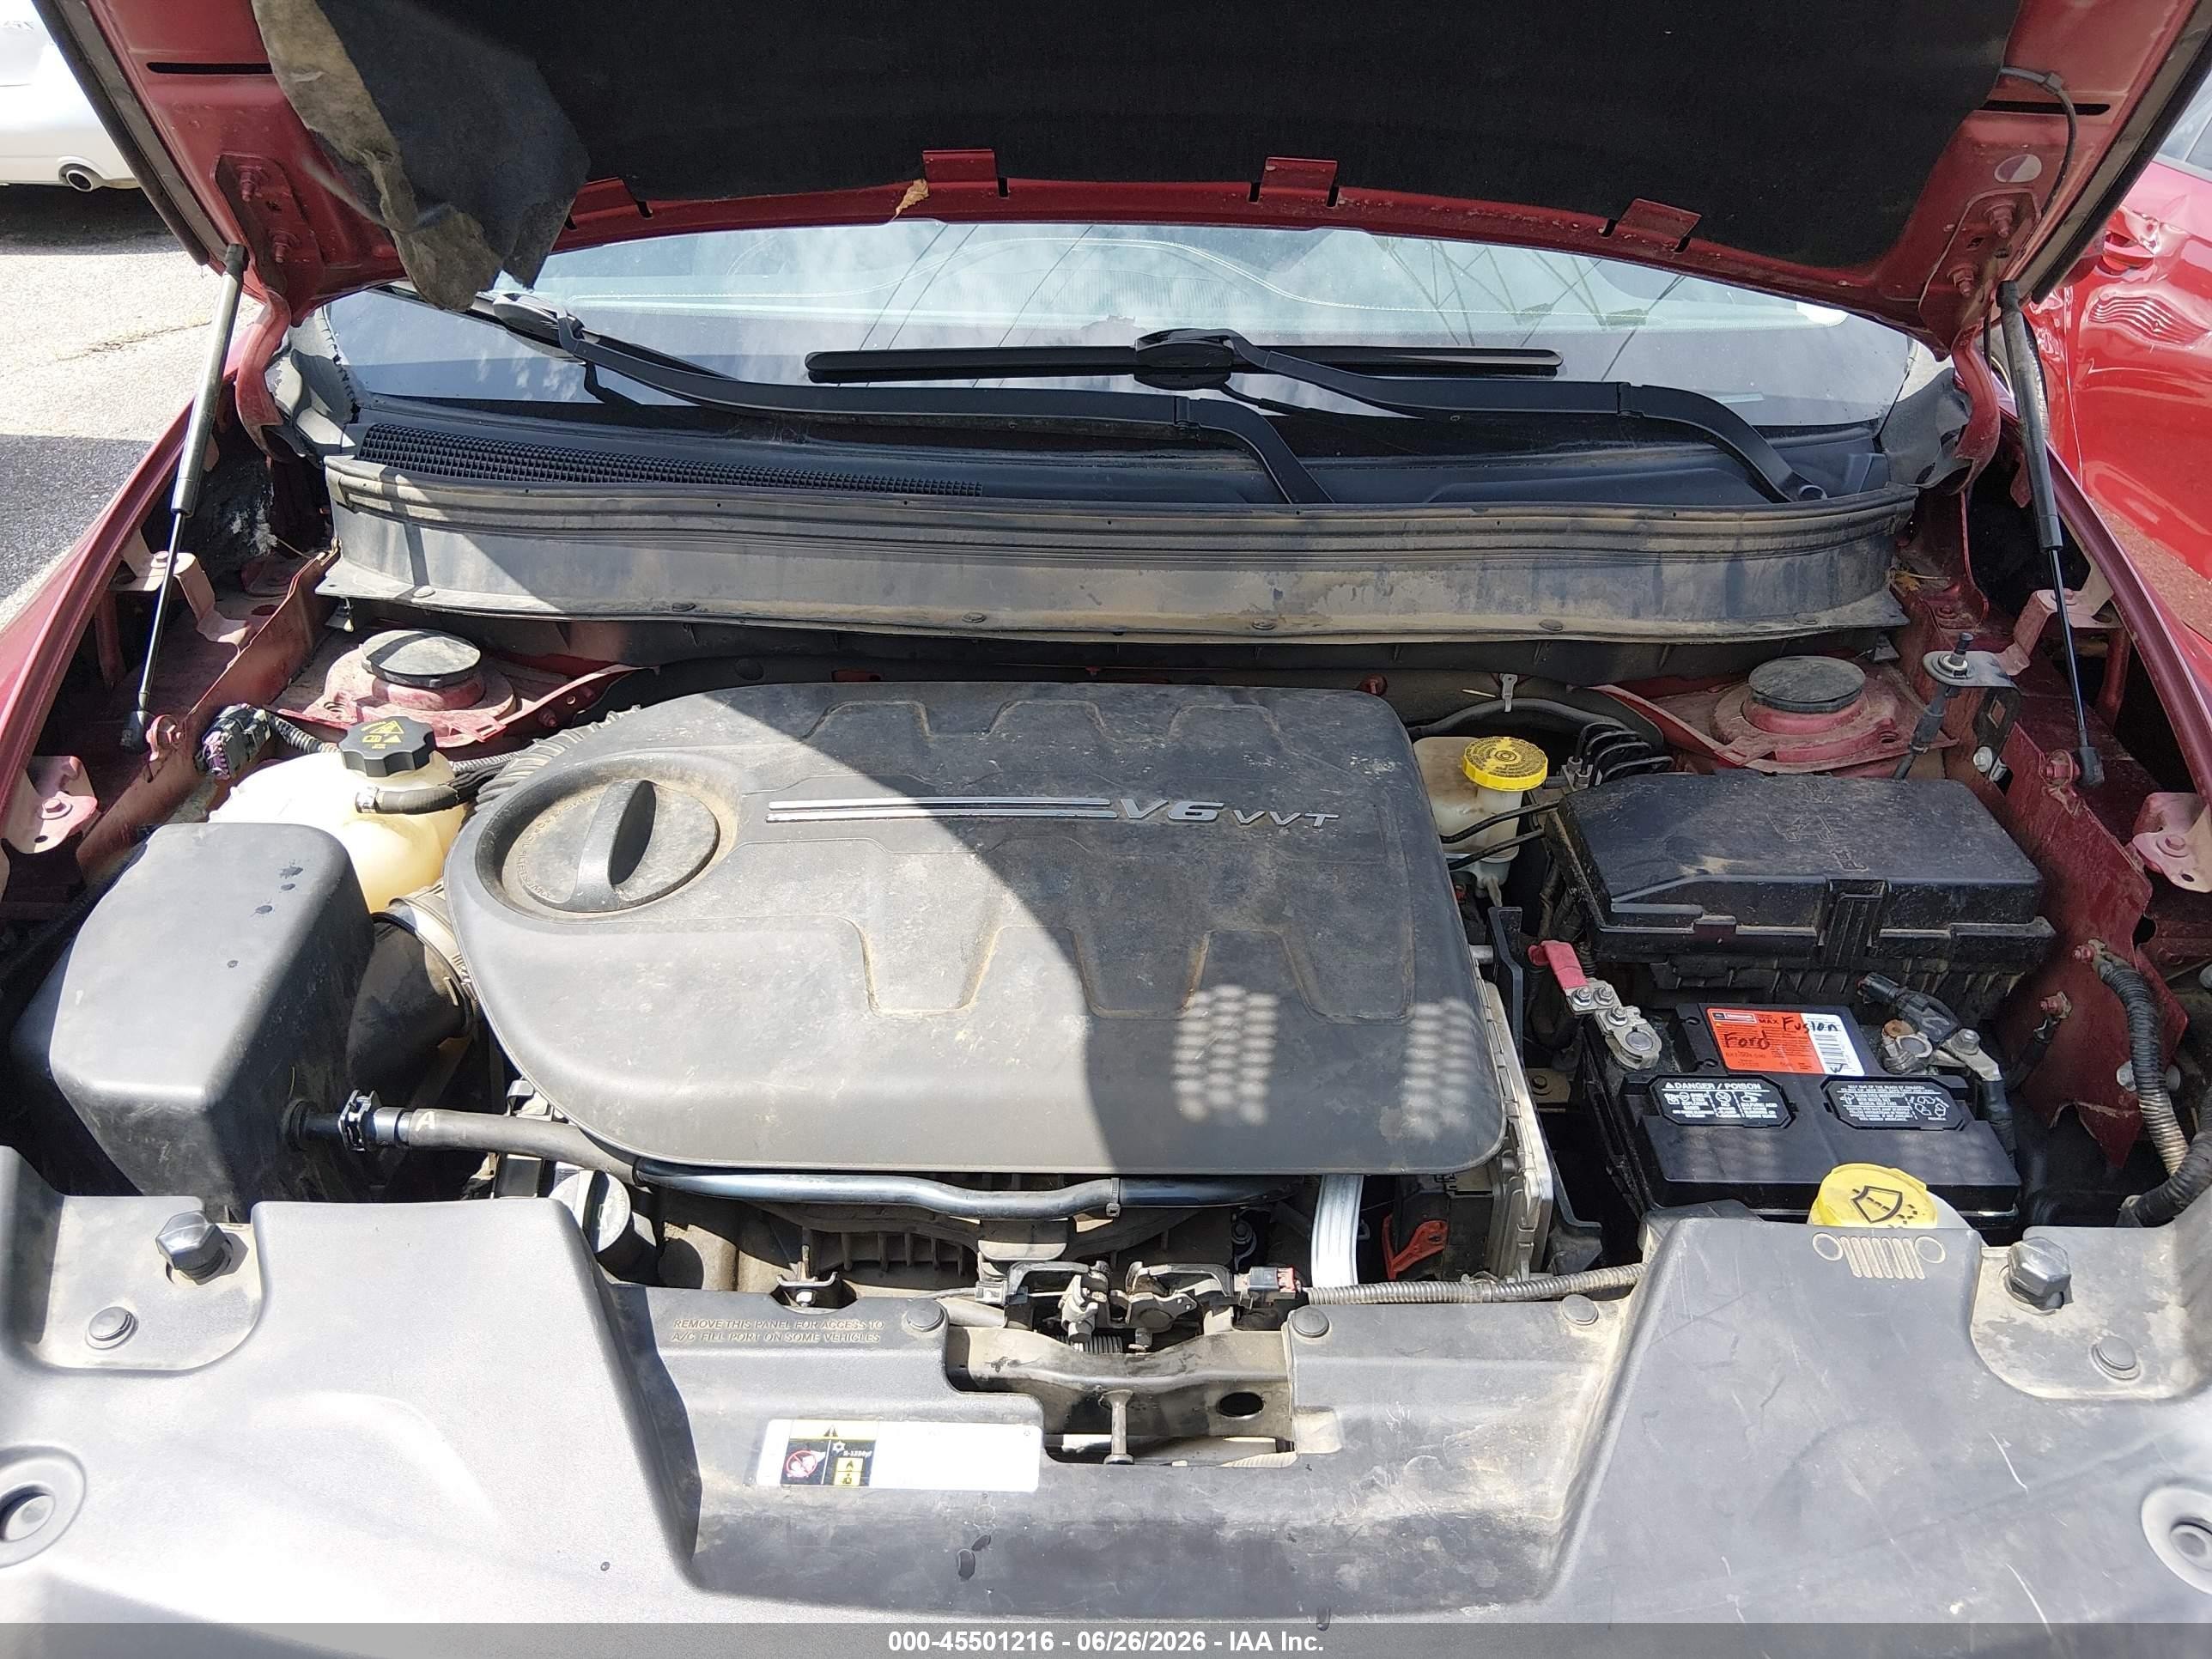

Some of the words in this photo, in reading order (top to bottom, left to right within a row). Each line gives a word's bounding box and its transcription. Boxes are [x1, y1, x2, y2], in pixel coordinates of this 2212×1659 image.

[1121, 798, 1224, 822] V6
[1233, 809, 1340, 830] VVT
[1782, 1016, 1839, 1034] Fusion
[1723, 1030, 1770, 1050] Ford
[416, 1111, 435, 1132] A
[673, 1319, 724, 1330] REMOVE
[726, 1319, 752, 1330] THIS
[755, 1319, 793, 1330] PANEL
[795, 1319, 818, 1330] FOR
[821, 1319, 866, 1330] ACCESS
[869, 1319, 885, 1330] TO
[672, 1332, 696, 1343] A/C
[700, 1332, 726, 1343] FILL
[729, 1332, 761, 1343] PORT
[763, 1332, 783, 1343] ON
[786, 1332, 821, 1343] SOME
[823, 1332, 881, 1343] VEHICLES
